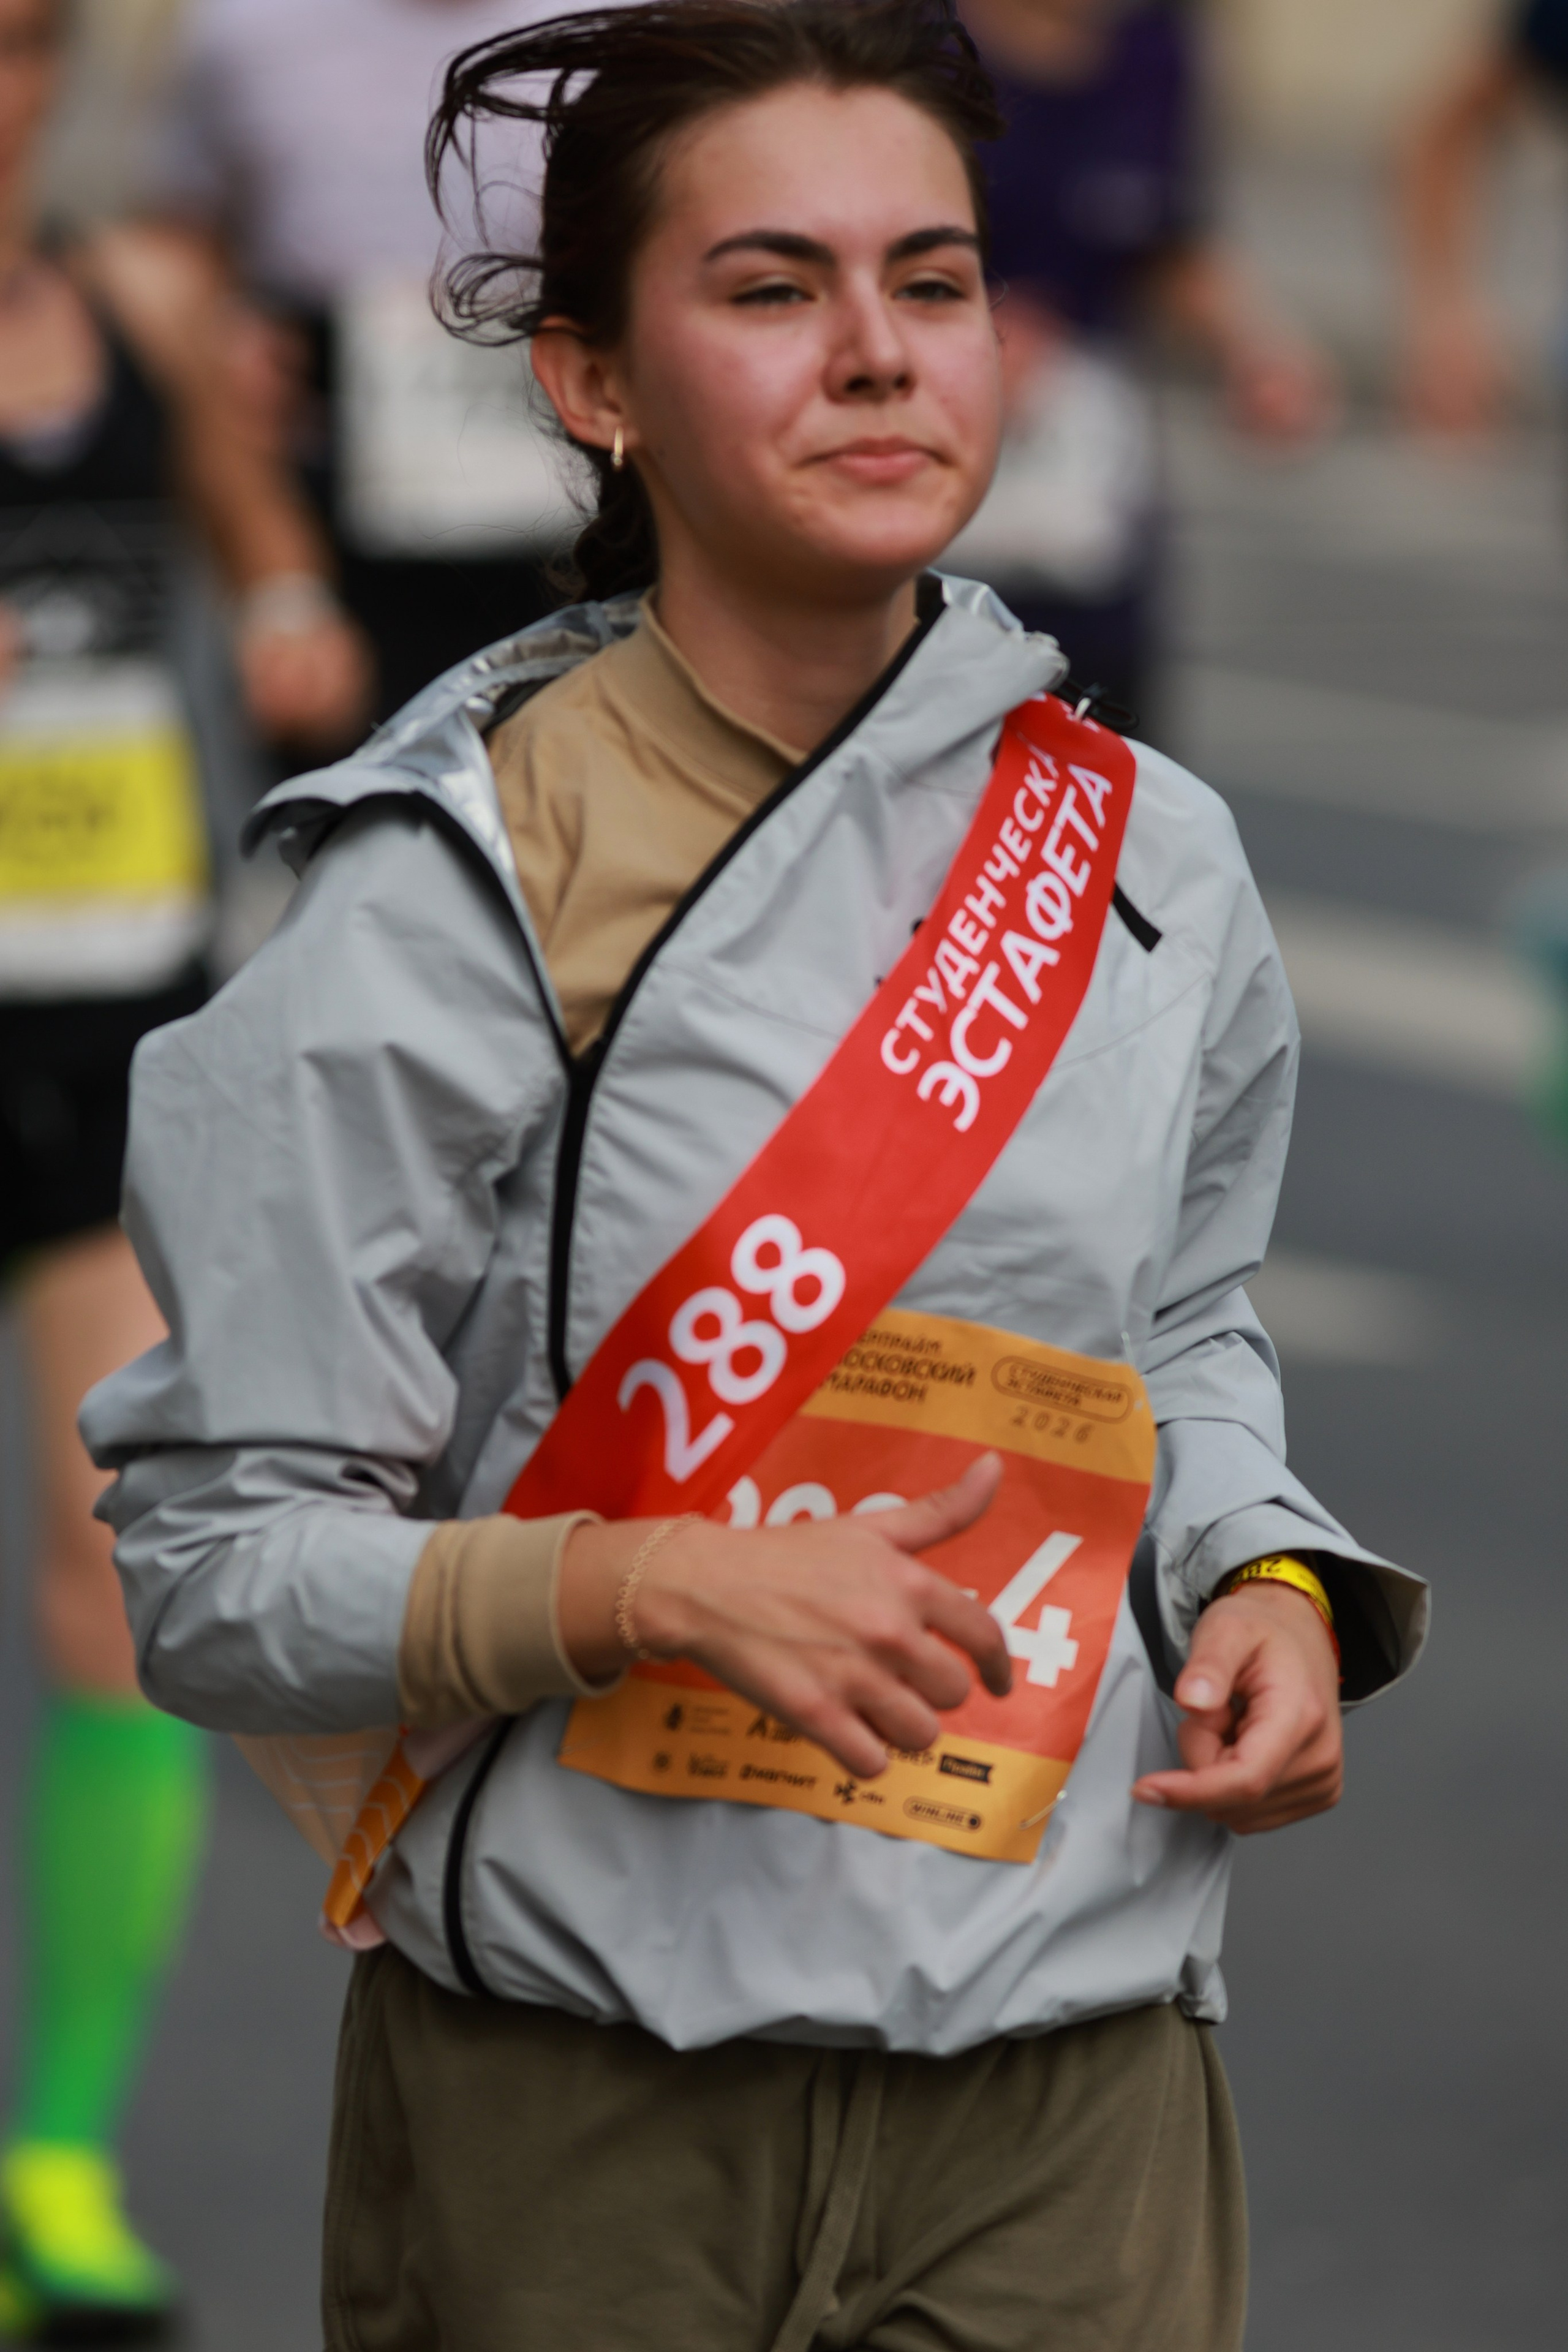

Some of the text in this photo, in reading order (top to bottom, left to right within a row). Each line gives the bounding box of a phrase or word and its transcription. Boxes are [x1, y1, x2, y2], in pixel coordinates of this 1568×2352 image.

[881, 733, 1059, 1075] СТУДЕНЧЕСКА
[917, 763, 1112, 1132] ЭСТАФЕТА
[616, 1213, 846, 1483] 288
[842, 1346, 977, 1389] ОСКОВСКИЙ
[858, 1328, 942, 1356] ЕРПРАЙМ
[1011, 1405, 1093, 1444] 2026
